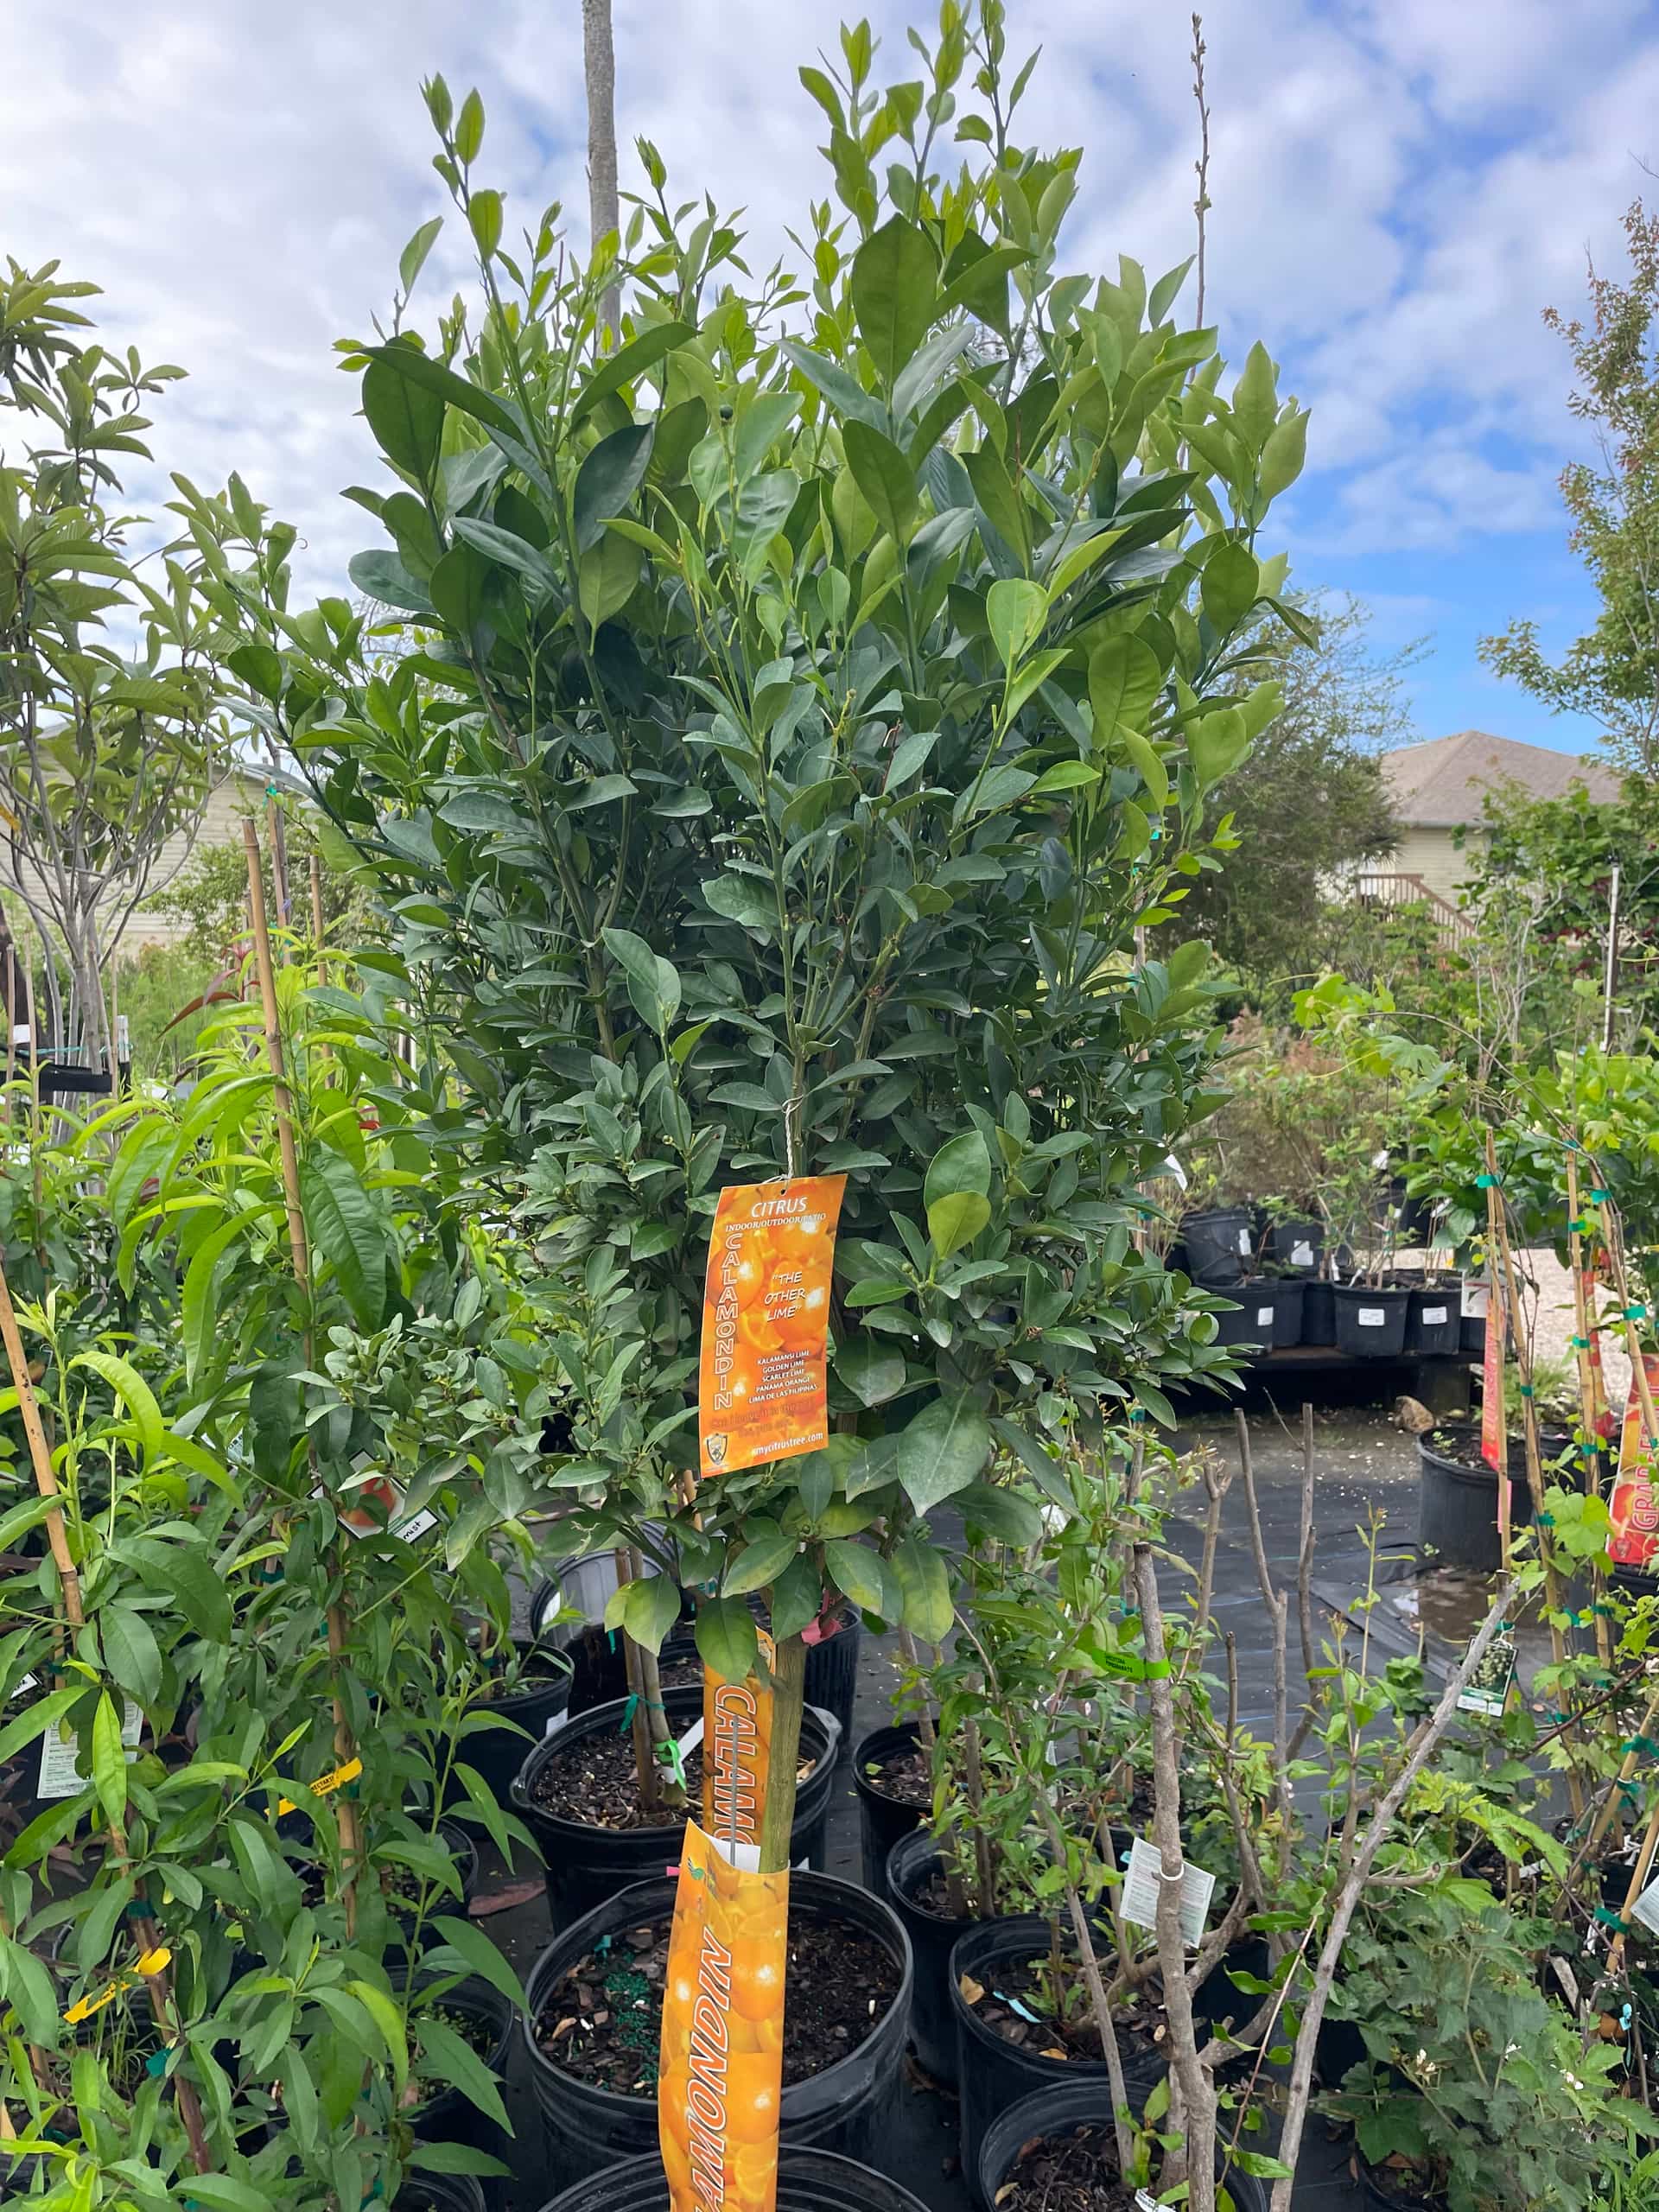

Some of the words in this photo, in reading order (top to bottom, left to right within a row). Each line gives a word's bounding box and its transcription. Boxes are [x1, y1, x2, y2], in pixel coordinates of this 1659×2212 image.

[752, 1197, 808, 1218] CITRUS
[765, 1287, 806, 1306] OTHER
[714, 1233, 743, 1411] CALAMONDIN
[758, 1352, 795, 1365] KALAMANSI
[762, 1363, 790, 1374] GOLDEN
[762, 1370, 790, 1382] SCARLET
[749, 1395, 766, 1404] LIMA
[766, 1392, 776, 1401] DE
[776, 1389, 789, 1399] LAS
[789, 1383, 817, 1395] FILIPINAS
[756, 1382, 784, 1393] PANAMA
[687, 1926, 732, 2212] AMONDIN
